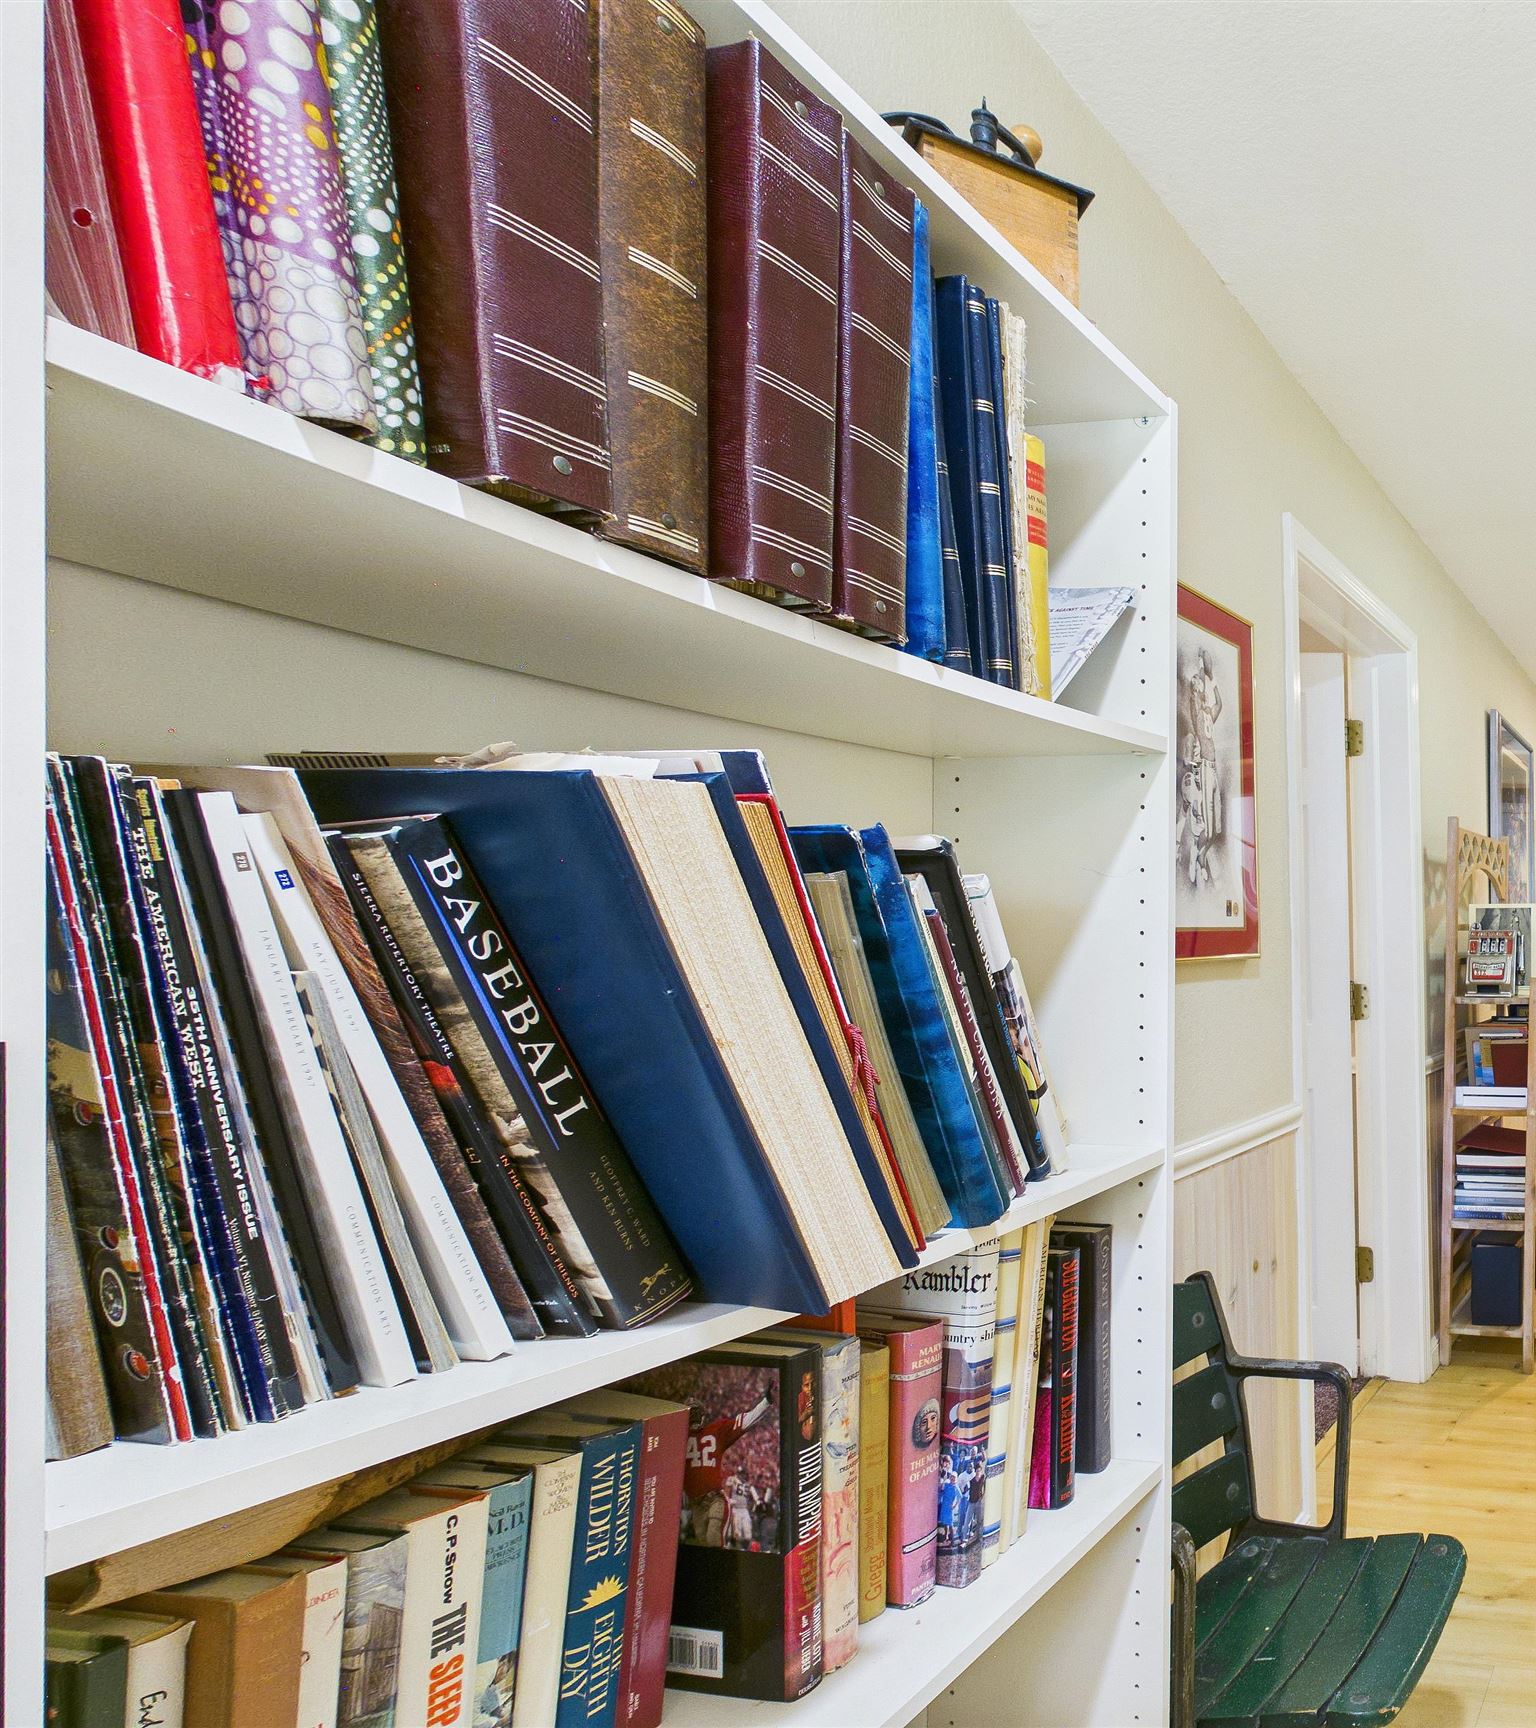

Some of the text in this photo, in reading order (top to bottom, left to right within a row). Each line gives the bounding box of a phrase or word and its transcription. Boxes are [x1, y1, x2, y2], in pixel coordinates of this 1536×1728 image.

[235, 855, 250, 871] 270
[276, 871, 292, 888] 272
[131, 827, 206, 1089] THE AMERICAN WEST
[351, 872, 455, 1061] SIERRA REPERTORY THEATRE
[423, 848, 589, 1136] BASEBALL
[950, 957, 974, 1022] NORTH
[972, 1029, 1005, 1121] CAROLINA
[201, 1045, 242, 1181] ANNIVERSARY
[237, 1182, 260, 1240] ISSUE
[499, 1153, 580, 1298] IN THE COMPANY OF FRIENDS
[589, 1169, 635, 1252] AND KEN BURNS
[600, 1154, 631, 1206] GEOFFREY
[632, 1217, 652, 1249] WARD
[345, 1204, 393, 1337] COMMUNICATION ARTS
[430, 1195, 476, 1283] COMMUNICATION
[472, 1287, 489, 1312] ARTS
[902, 1264, 992, 1295] Rambler
[1037, 1242, 1049, 1303] AMERICAN
[632, 1276, 686, 1312] KNOPF
[1060, 1258, 1079, 1353] SUE GRAFTON
[919, 1342, 942, 1358] MARY
[942, 1330, 977, 1348] ountry
[685, 1434, 717, 1468] 42
[798, 1438, 822, 1492] TOTAL
[909, 1469, 921, 1484] OF
[910, 1456, 926, 1472] THE
[585, 1451, 617, 1565] WILDER
[613, 1444, 635, 1556] THORNTON
[798, 1483, 822, 1546] IMPACT
[864, 1550, 886, 1602] Gregg
[431, 1601, 467, 1661] THE
[800, 1627, 812, 1647] JILL
[812, 1601, 822, 1668] RONNIE LOTT
[561, 1642, 592, 1699] DAY
[586, 1610, 616, 1720] EIGHTH
